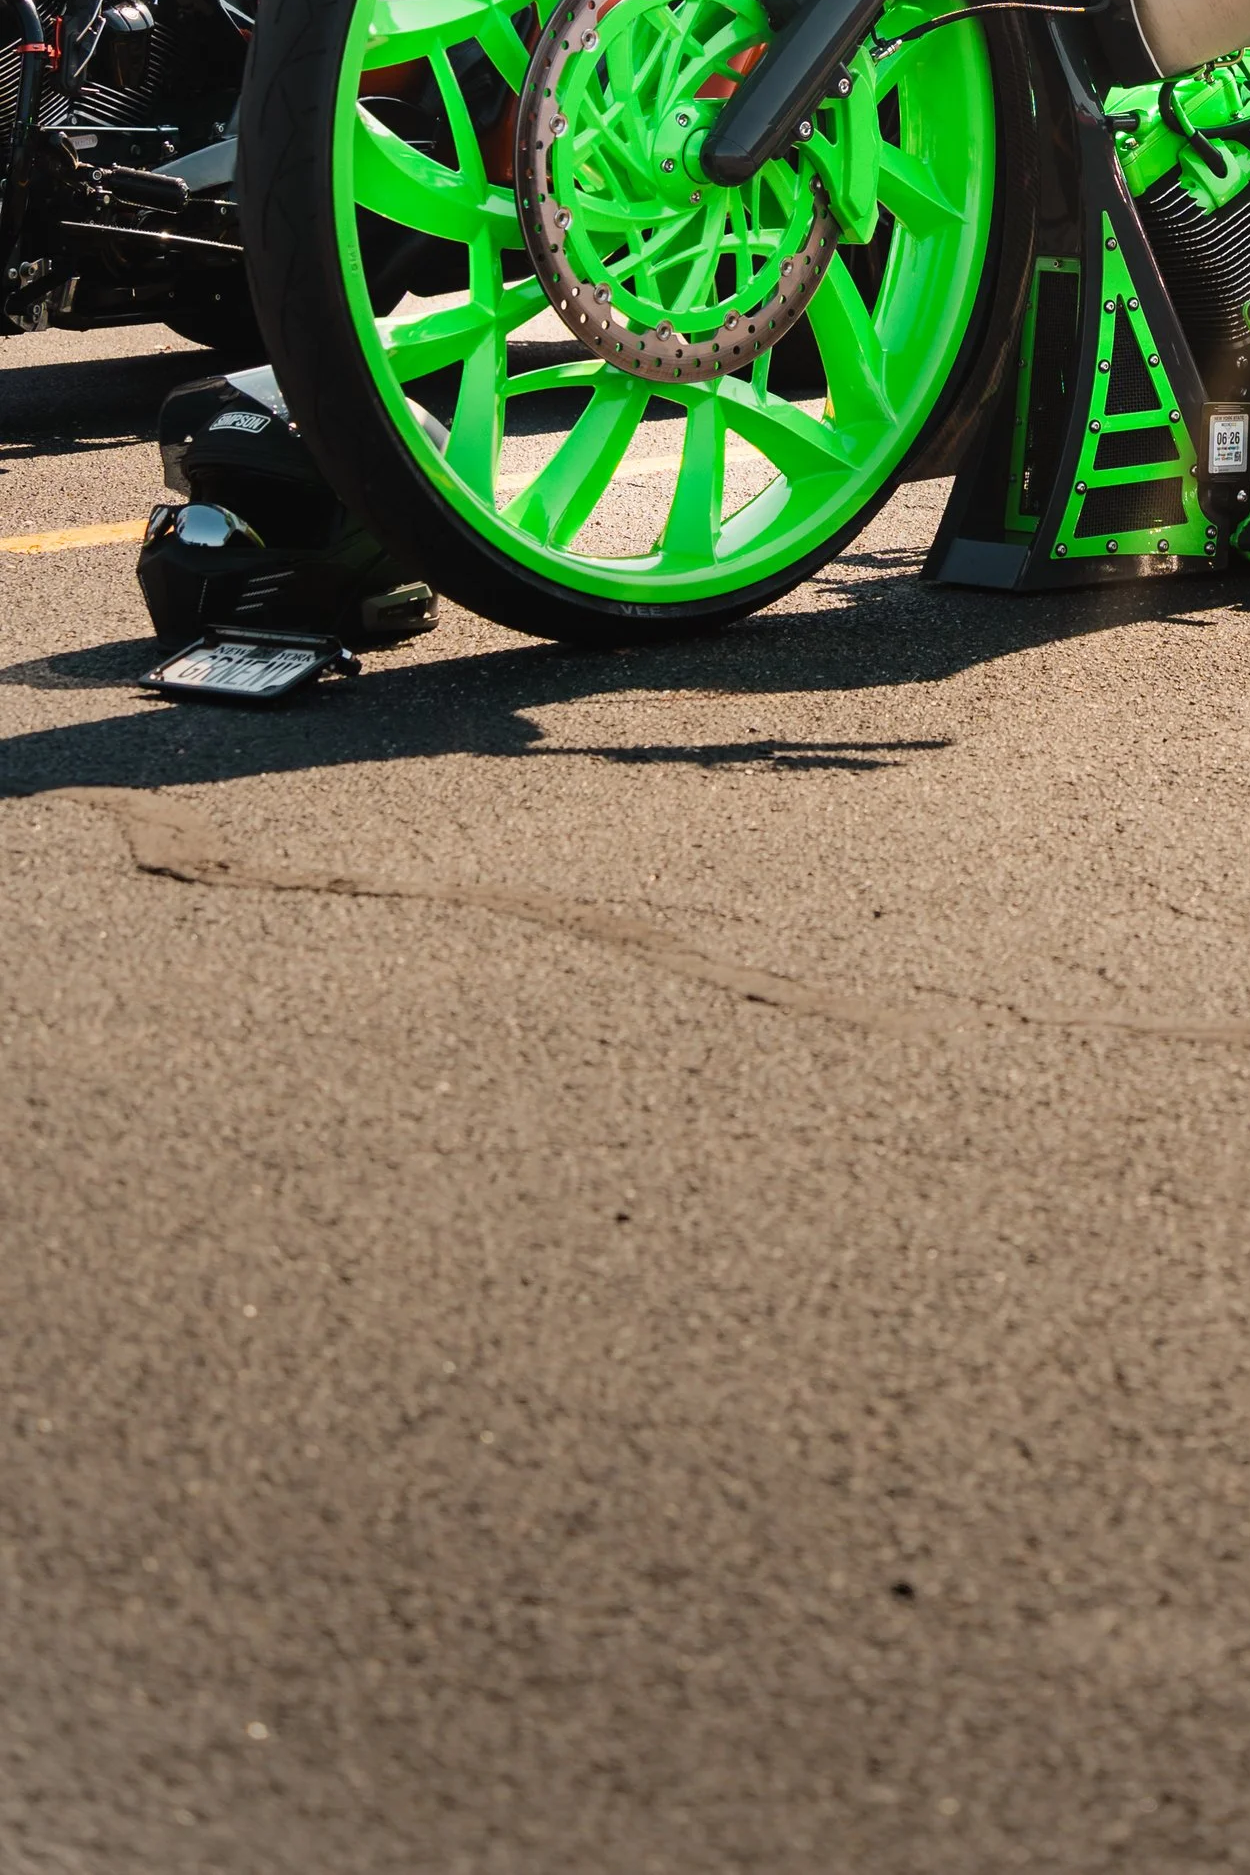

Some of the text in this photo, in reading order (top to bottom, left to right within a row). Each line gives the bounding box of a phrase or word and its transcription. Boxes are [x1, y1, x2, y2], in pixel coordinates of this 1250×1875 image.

[213, 414, 265, 430] SIMPSON
[214, 645, 315, 663] NEW YORK
